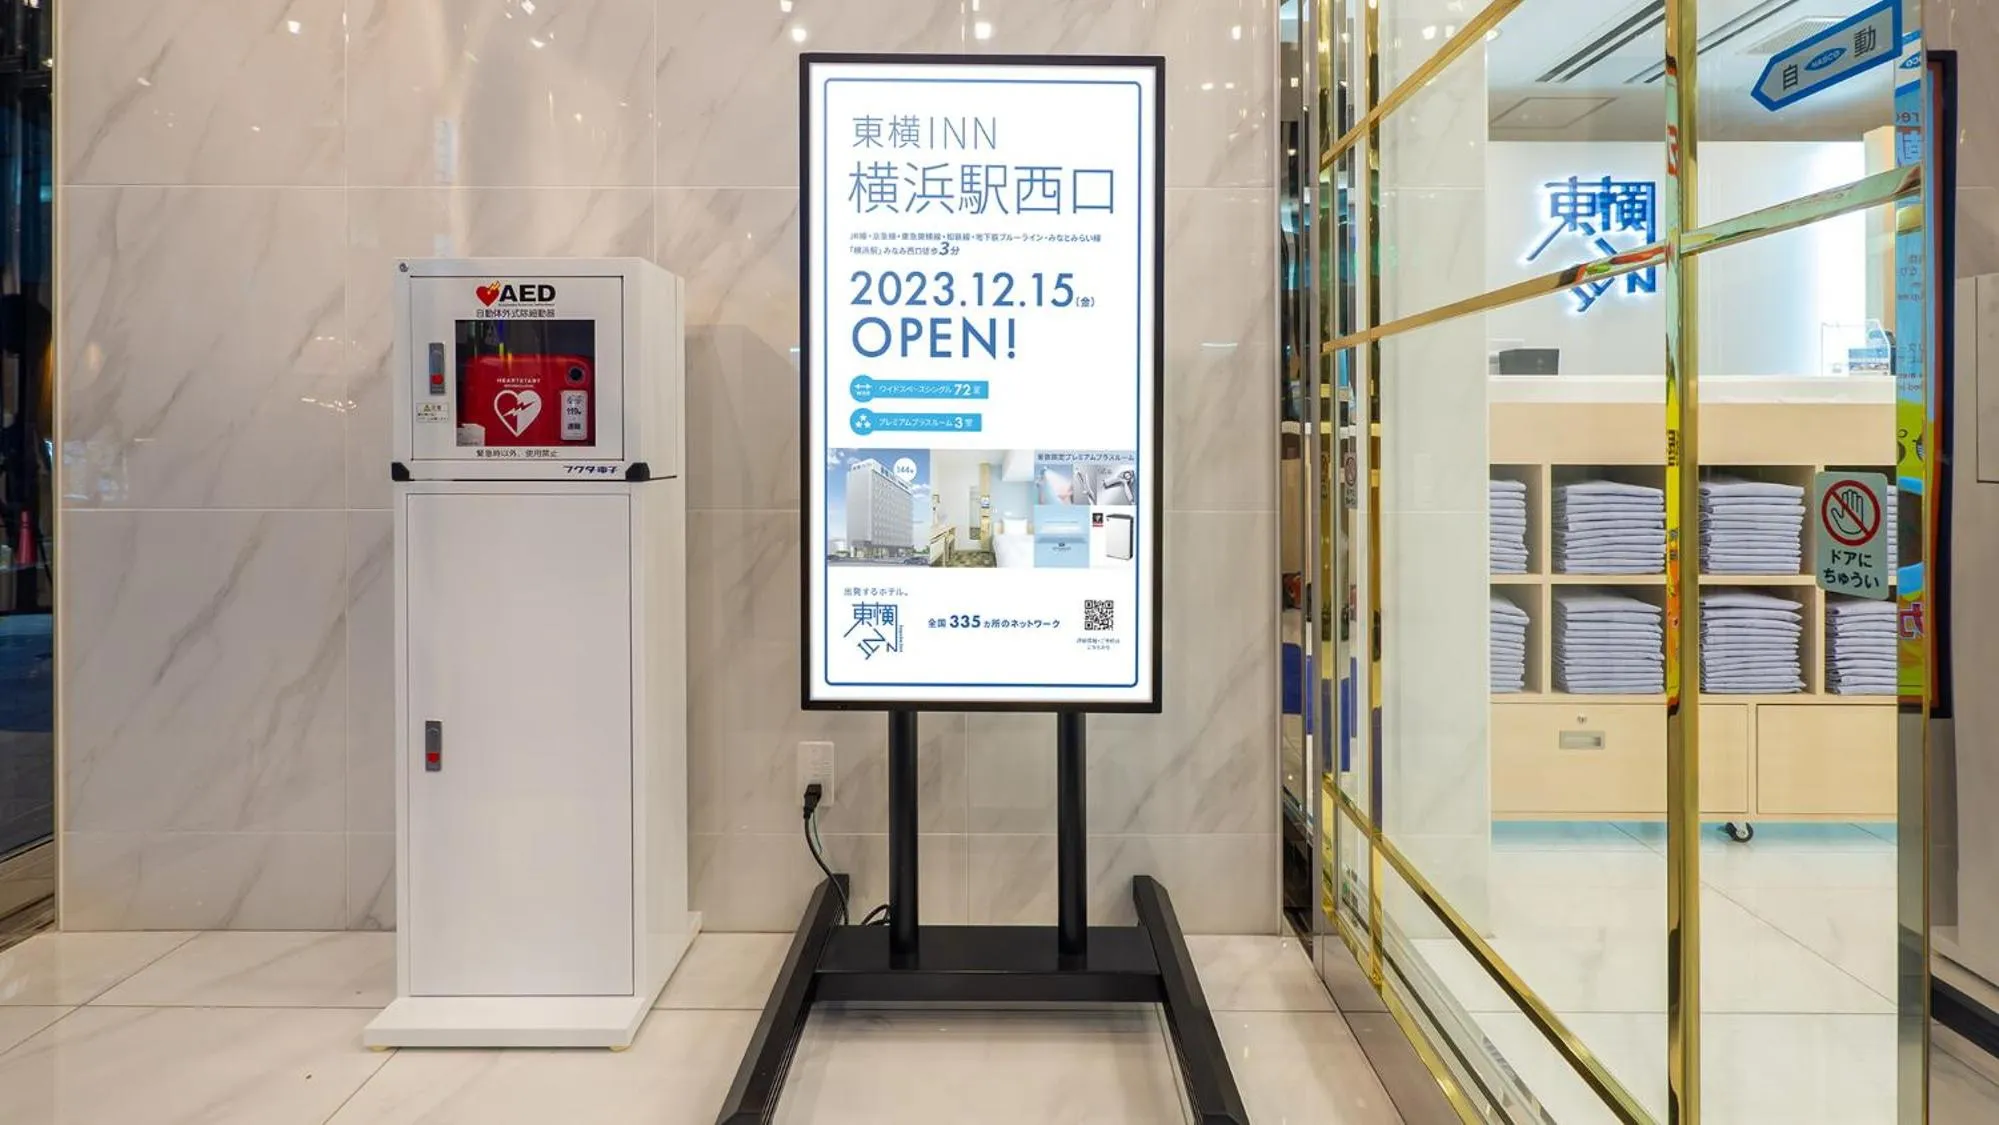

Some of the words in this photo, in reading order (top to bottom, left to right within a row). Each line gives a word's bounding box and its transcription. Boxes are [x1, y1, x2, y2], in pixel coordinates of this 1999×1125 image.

[1853, 24, 1878, 58] 動
[1782, 63, 1799, 91] 自
[852, 114, 997, 150] 東横INN
[848, 160, 1114, 215] 横浜駅西口
[499, 285, 556, 302] AED
[852, 316, 1016, 360] OPEN!
[1830, 549, 1873, 569] ドアに
[1823, 567, 1880, 589] ちゅうい
